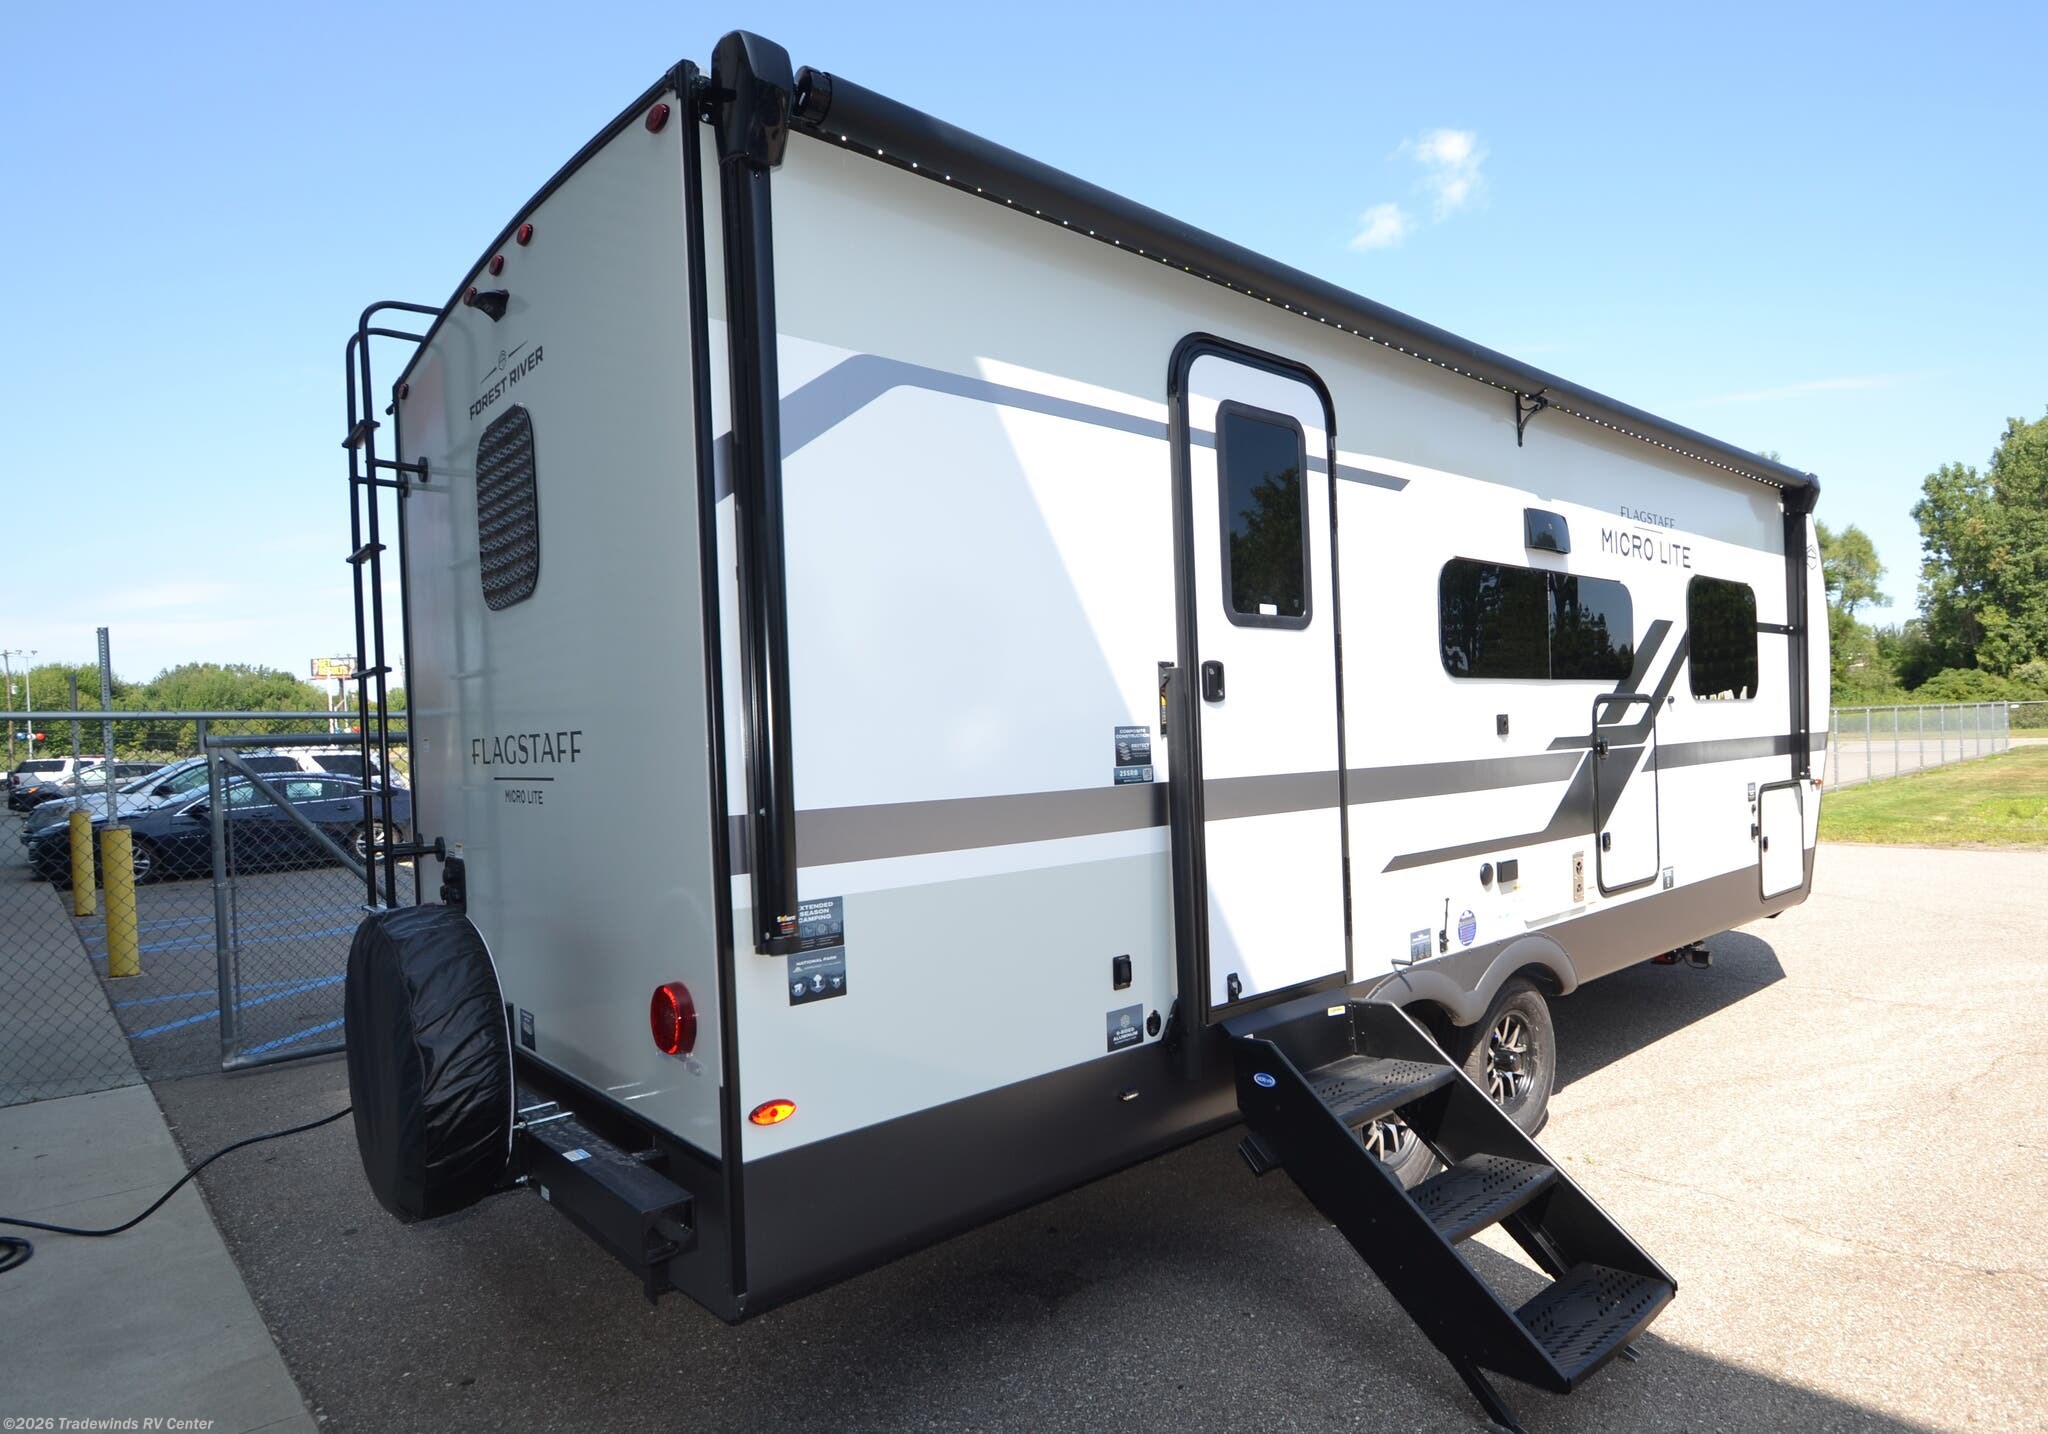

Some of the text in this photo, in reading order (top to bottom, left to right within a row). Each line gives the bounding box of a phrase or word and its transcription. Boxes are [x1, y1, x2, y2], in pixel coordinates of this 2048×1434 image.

[469, 345, 543, 420] FOREST RIVER
[1620, 505, 1676, 529] FLAGSTAFF
[1601, 527, 1691, 569] MICRO LITE
[471, 731, 582, 765] FLAGSTAFF
[505, 789, 543, 805] MICRO LITE
[799, 901, 834, 911] XTENDED
[799, 908, 830, 917] SEASON
